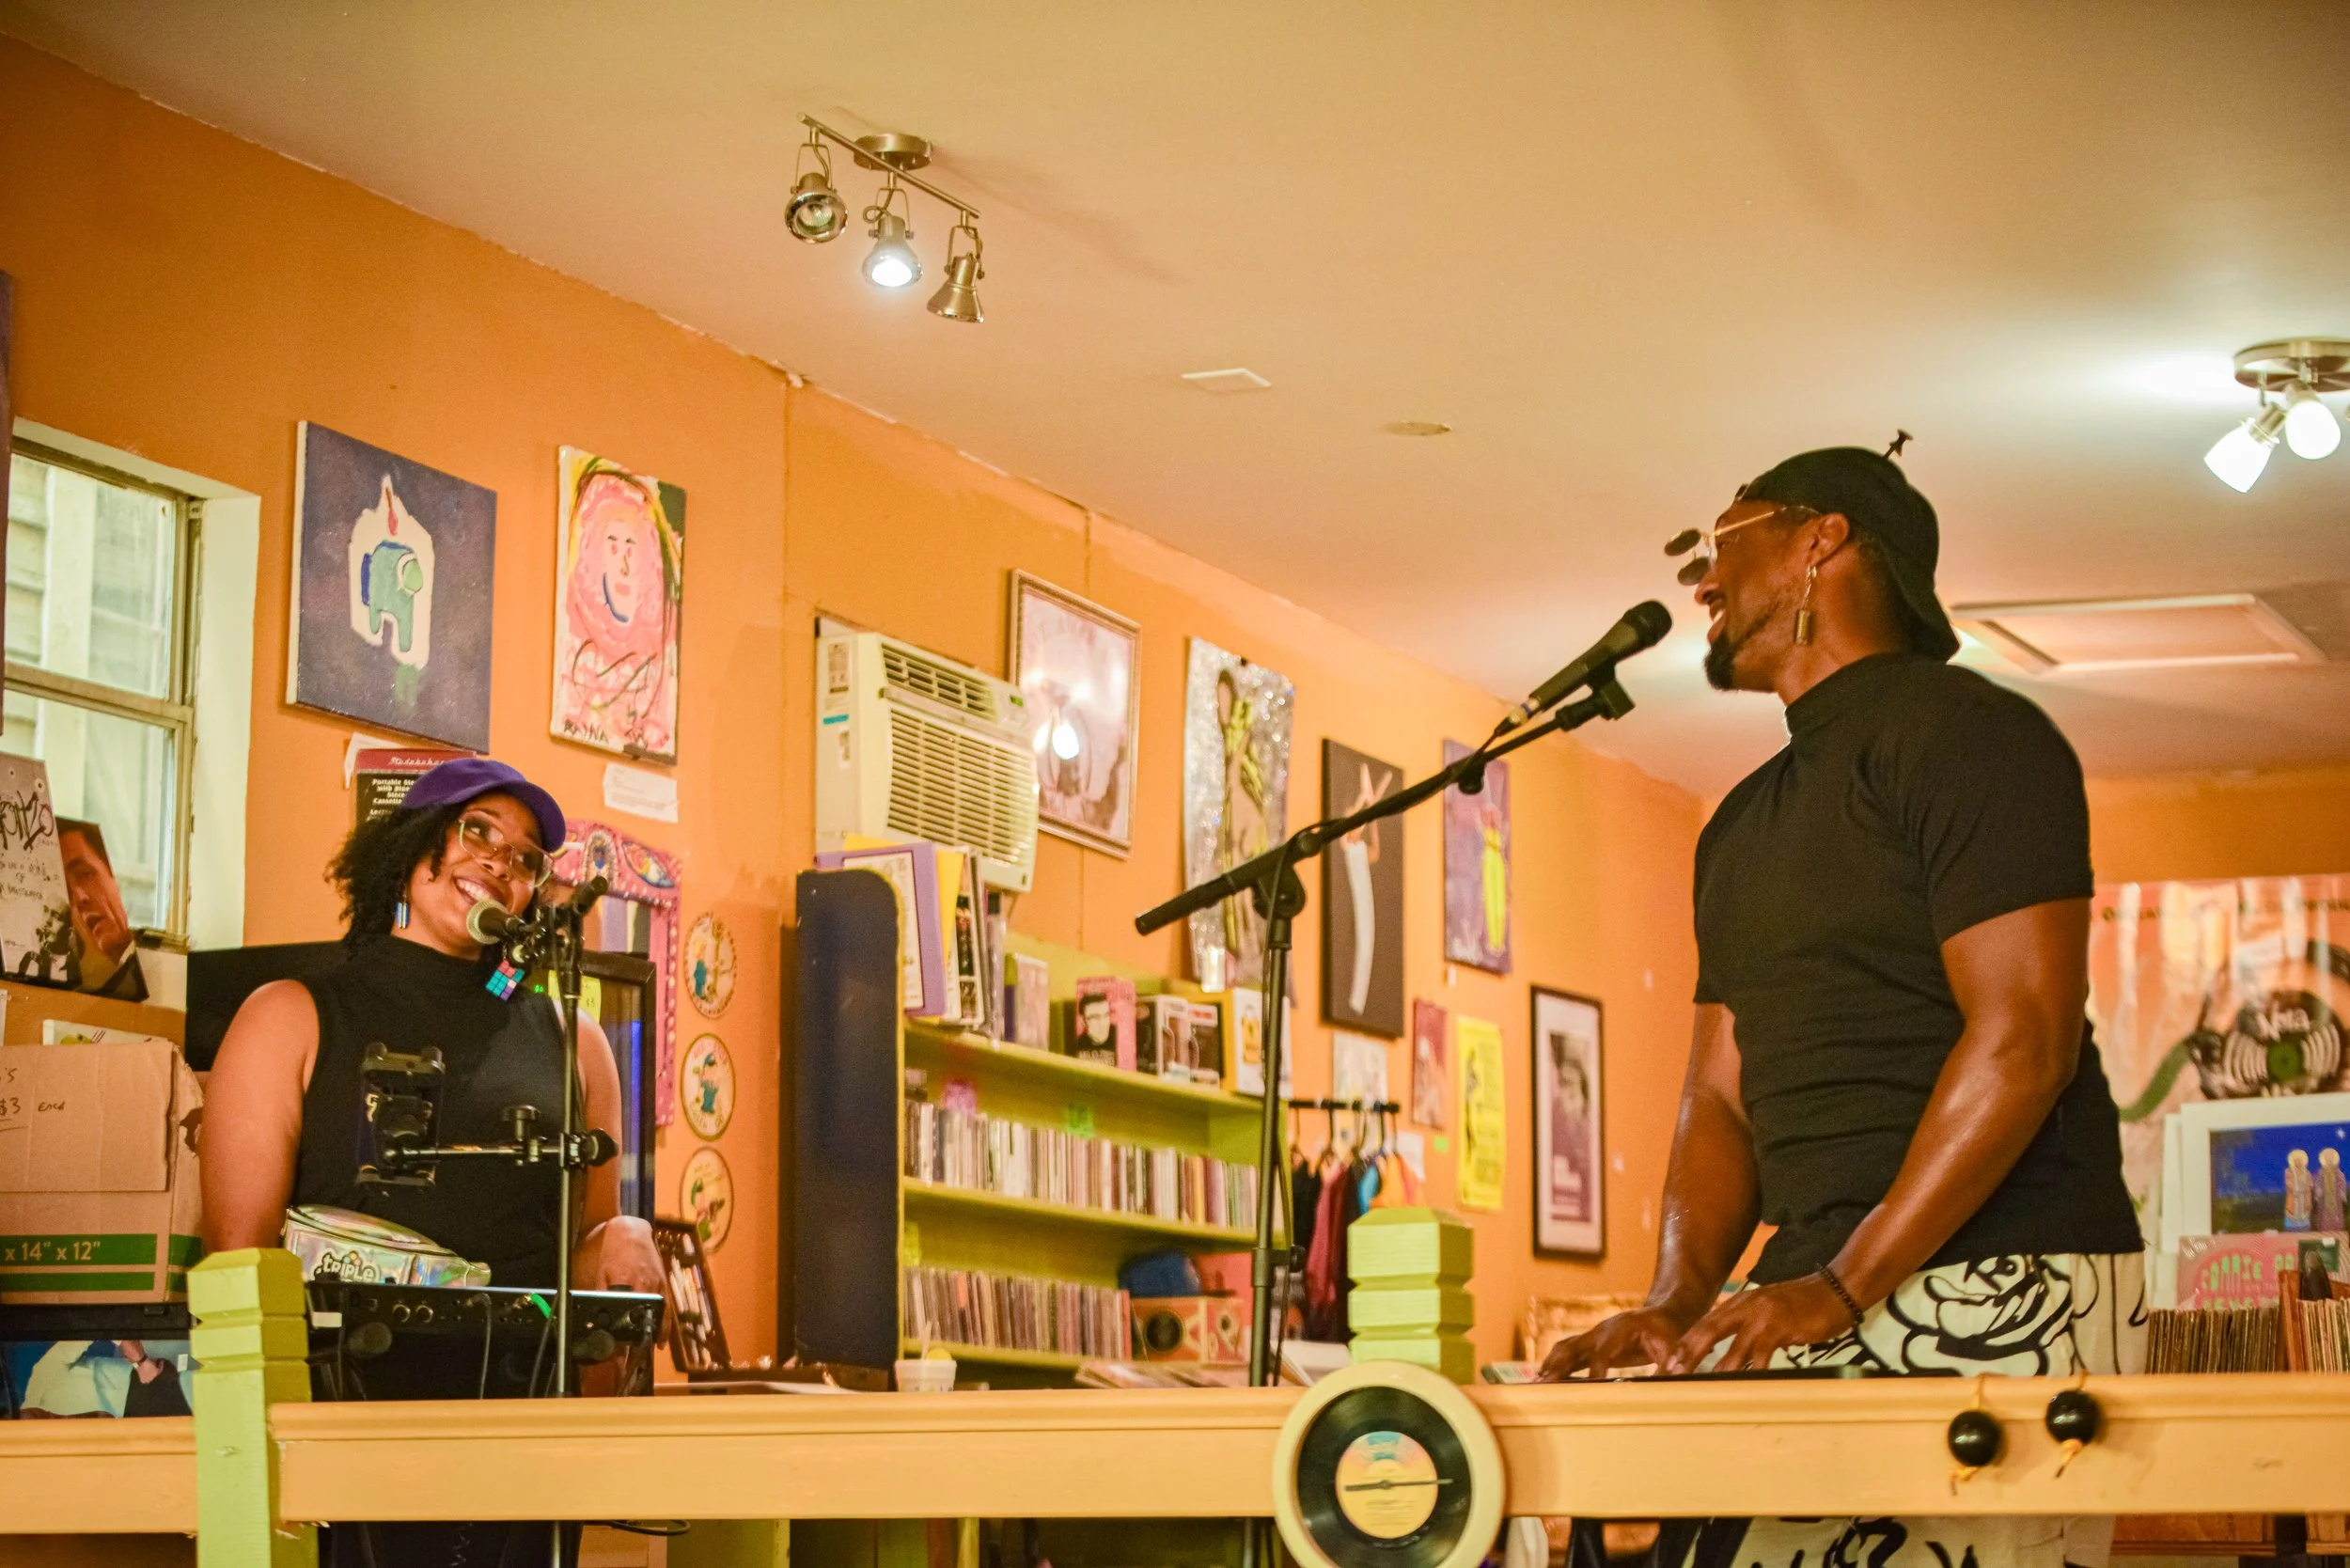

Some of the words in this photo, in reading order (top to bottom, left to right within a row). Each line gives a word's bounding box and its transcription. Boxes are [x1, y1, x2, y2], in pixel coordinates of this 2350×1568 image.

[5, 1247, 16, 1261] x
[22, 1241, 52, 1261] 14"
[56, 1247, 67, 1261] x
[73, 1241, 101, 1261] 12"
